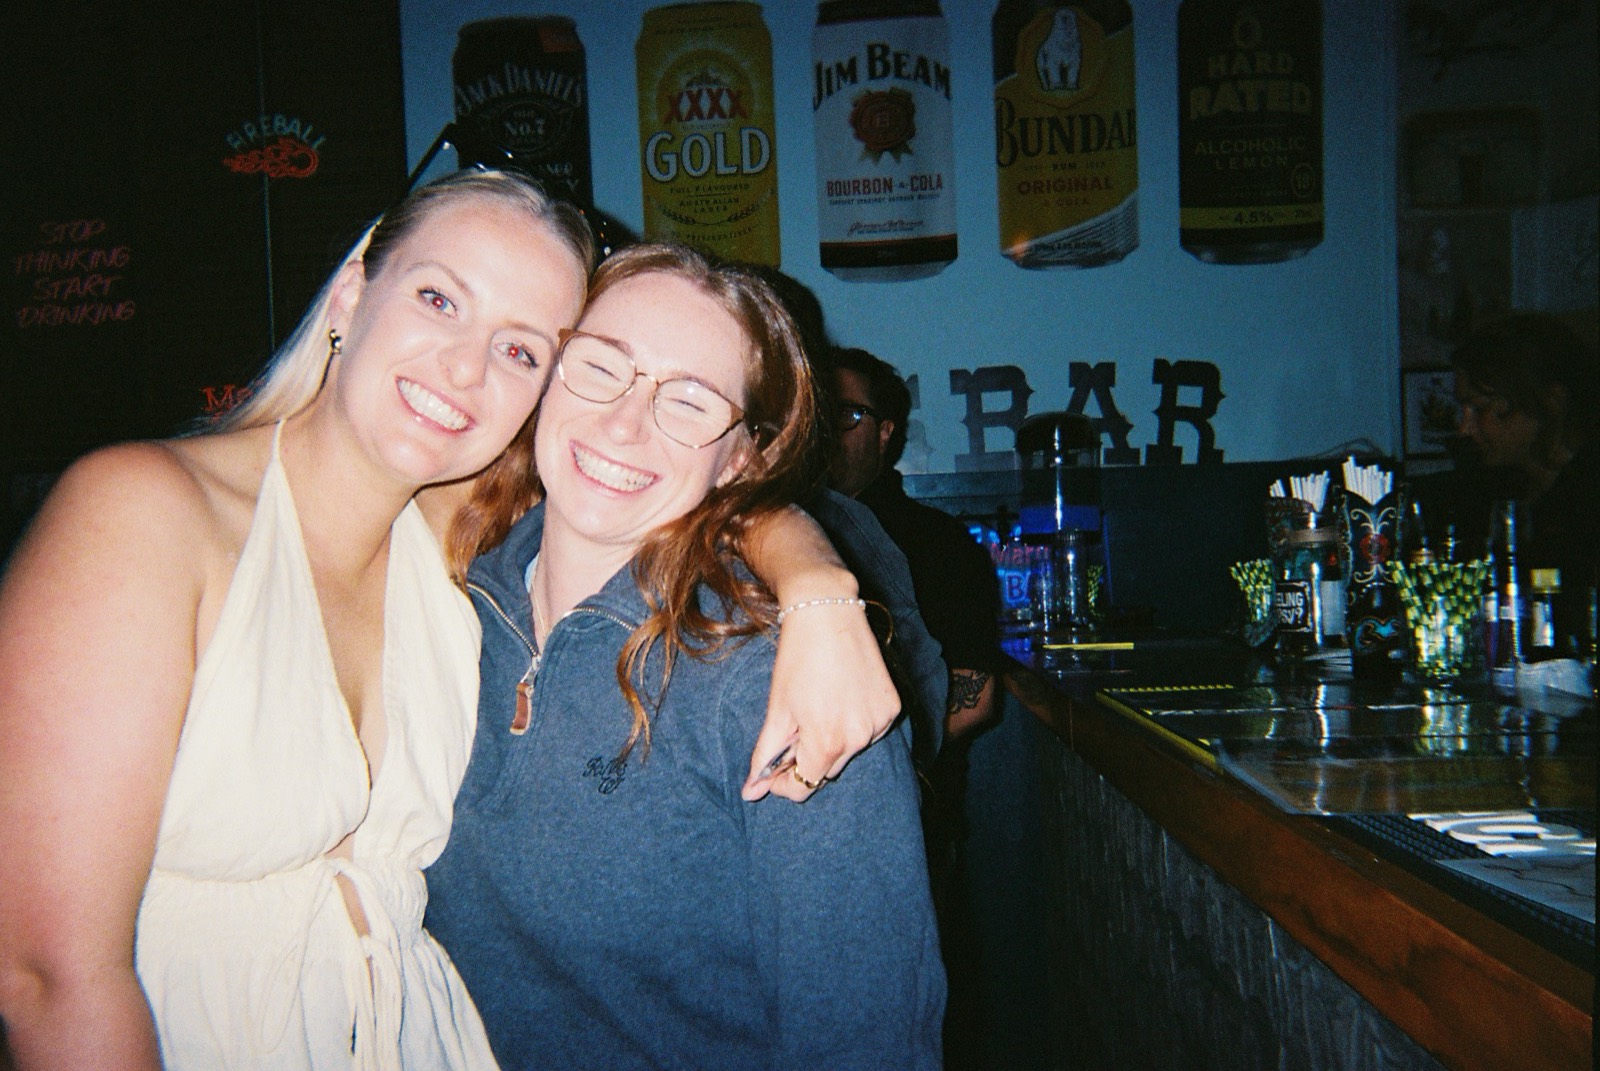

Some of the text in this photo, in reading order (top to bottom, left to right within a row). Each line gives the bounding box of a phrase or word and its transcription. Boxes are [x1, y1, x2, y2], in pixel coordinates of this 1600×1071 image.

[813, 42, 951, 112] JIM BEAM
[1207, 50, 1294, 78] HARD
[662, 88, 750, 125] XXXX
[1189, 80, 1313, 122] RATED
[223, 111, 327, 150] FIREBALL
[644, 126, 771, 183] GOLD
[1195, 137, 1307, 156] ALCOHOLIC
[1215, 155, 1289, 171] LEMON
[826, 176, 893, 197] BOURBON
[909, 173, 944, 192] COLA
[1017, 175, 1114, 196] ORIGINAL
[40, 218, 106, 246] STOP
[14, 244, 133, 275] THINKING
[32, 273, 125, 301] START
[16, 299, 136, 328] DRINKING
[949, 358, 1226, 472] BAR
